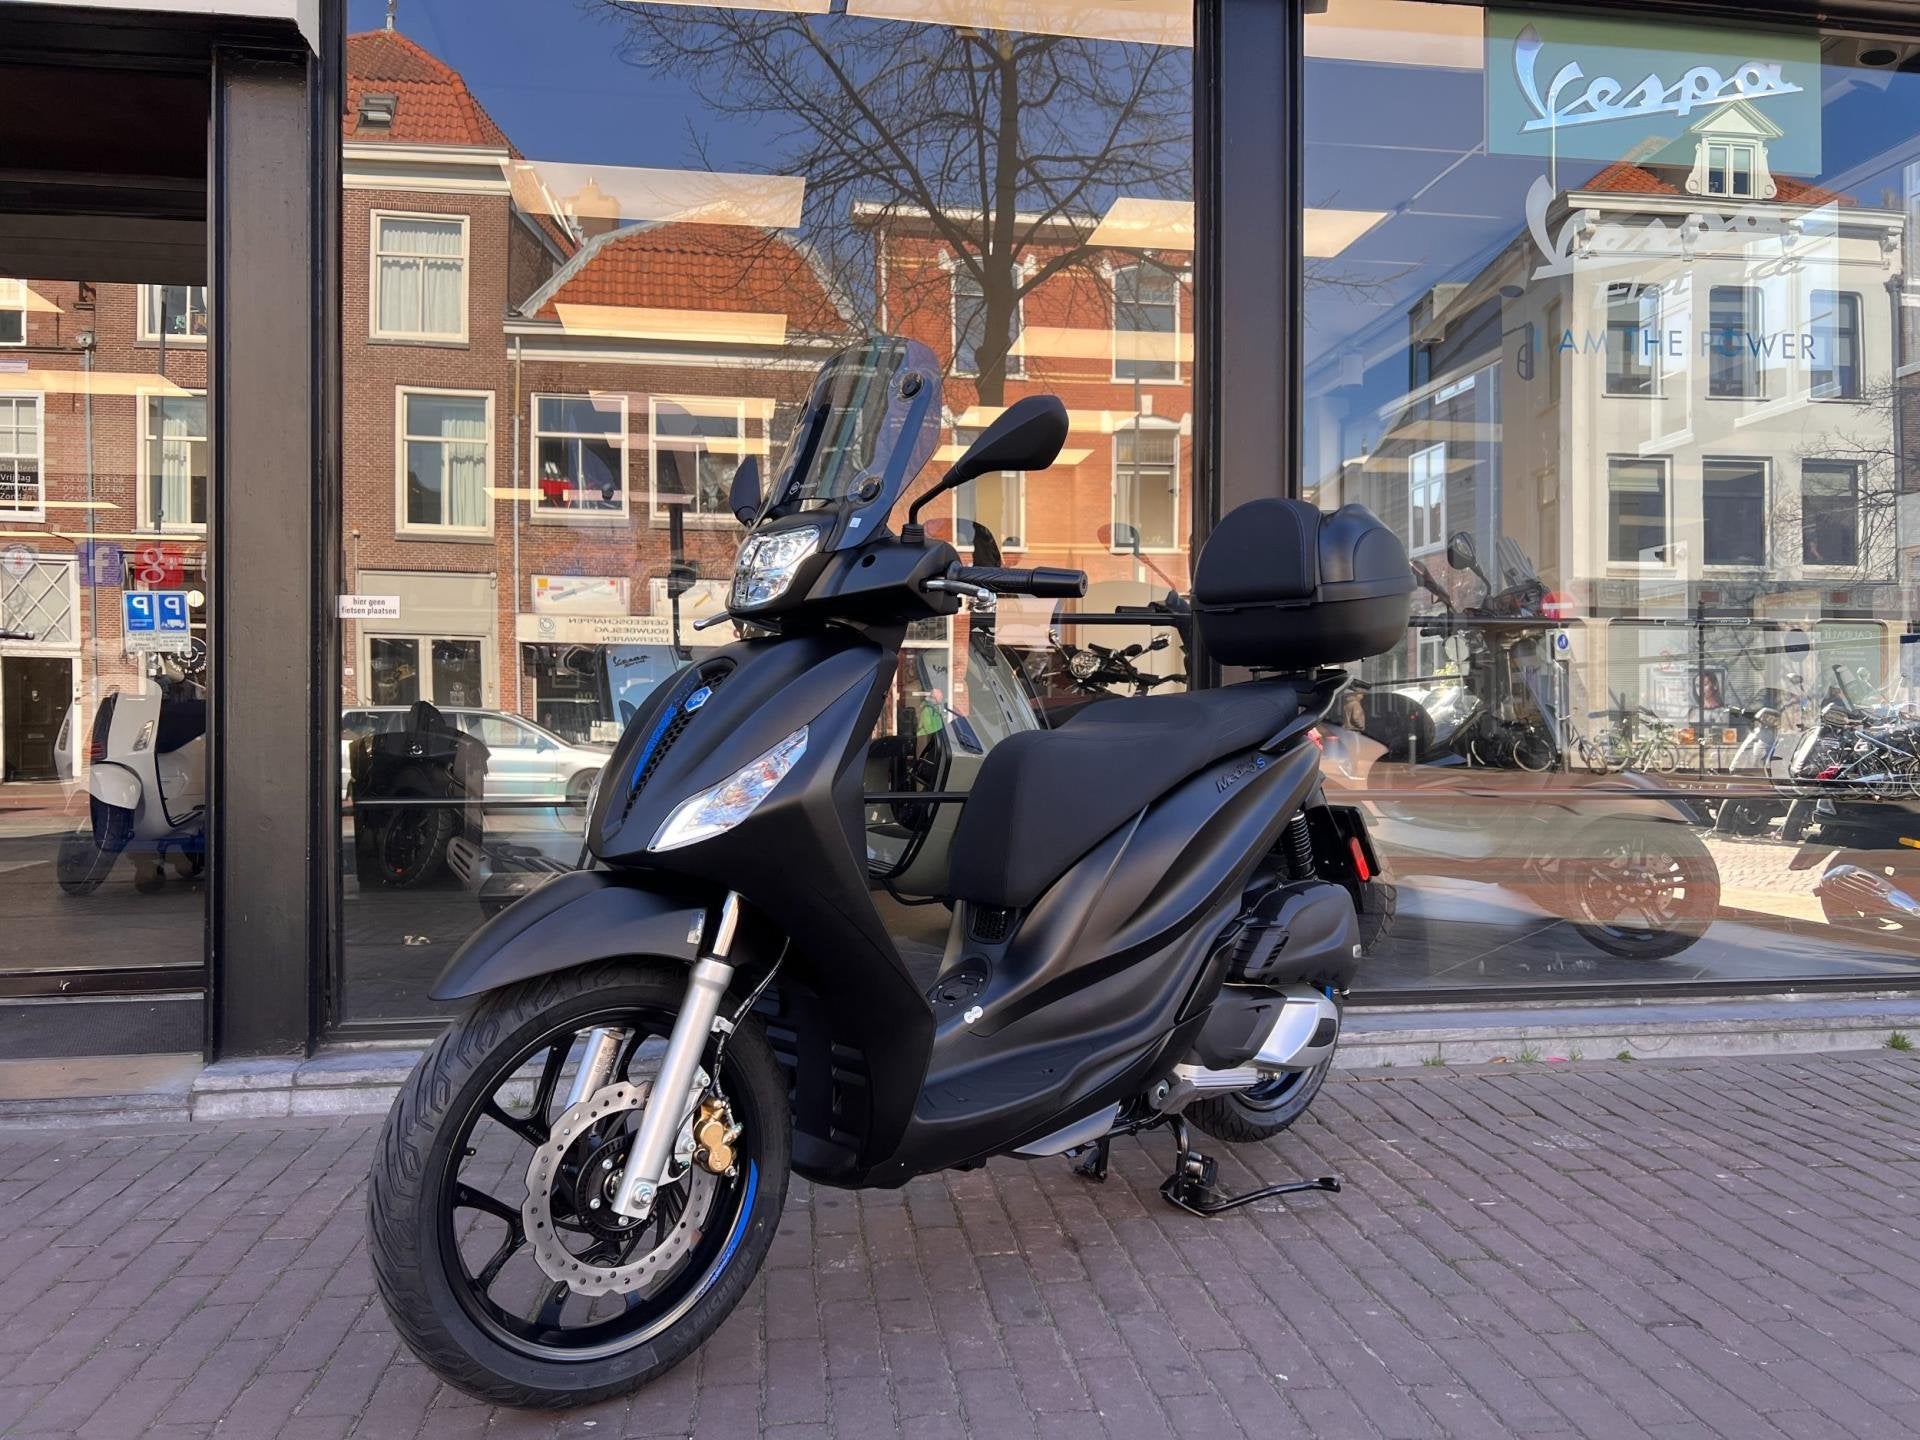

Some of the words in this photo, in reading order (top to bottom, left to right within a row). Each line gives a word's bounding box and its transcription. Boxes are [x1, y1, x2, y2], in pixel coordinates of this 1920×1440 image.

[1513, 22, 1804, 134] Vespa
[1557, 328, 1608, 355] AM
[1624, 330, 1682, 358] THE
[1701, 330, 1816, 360] POWER
[341, 606, 366, 614] fietsen
[367, 607, 397, 615] plaatsen
[352, 597, 366, 605] hier
[368, 599, 386, 607] geen
